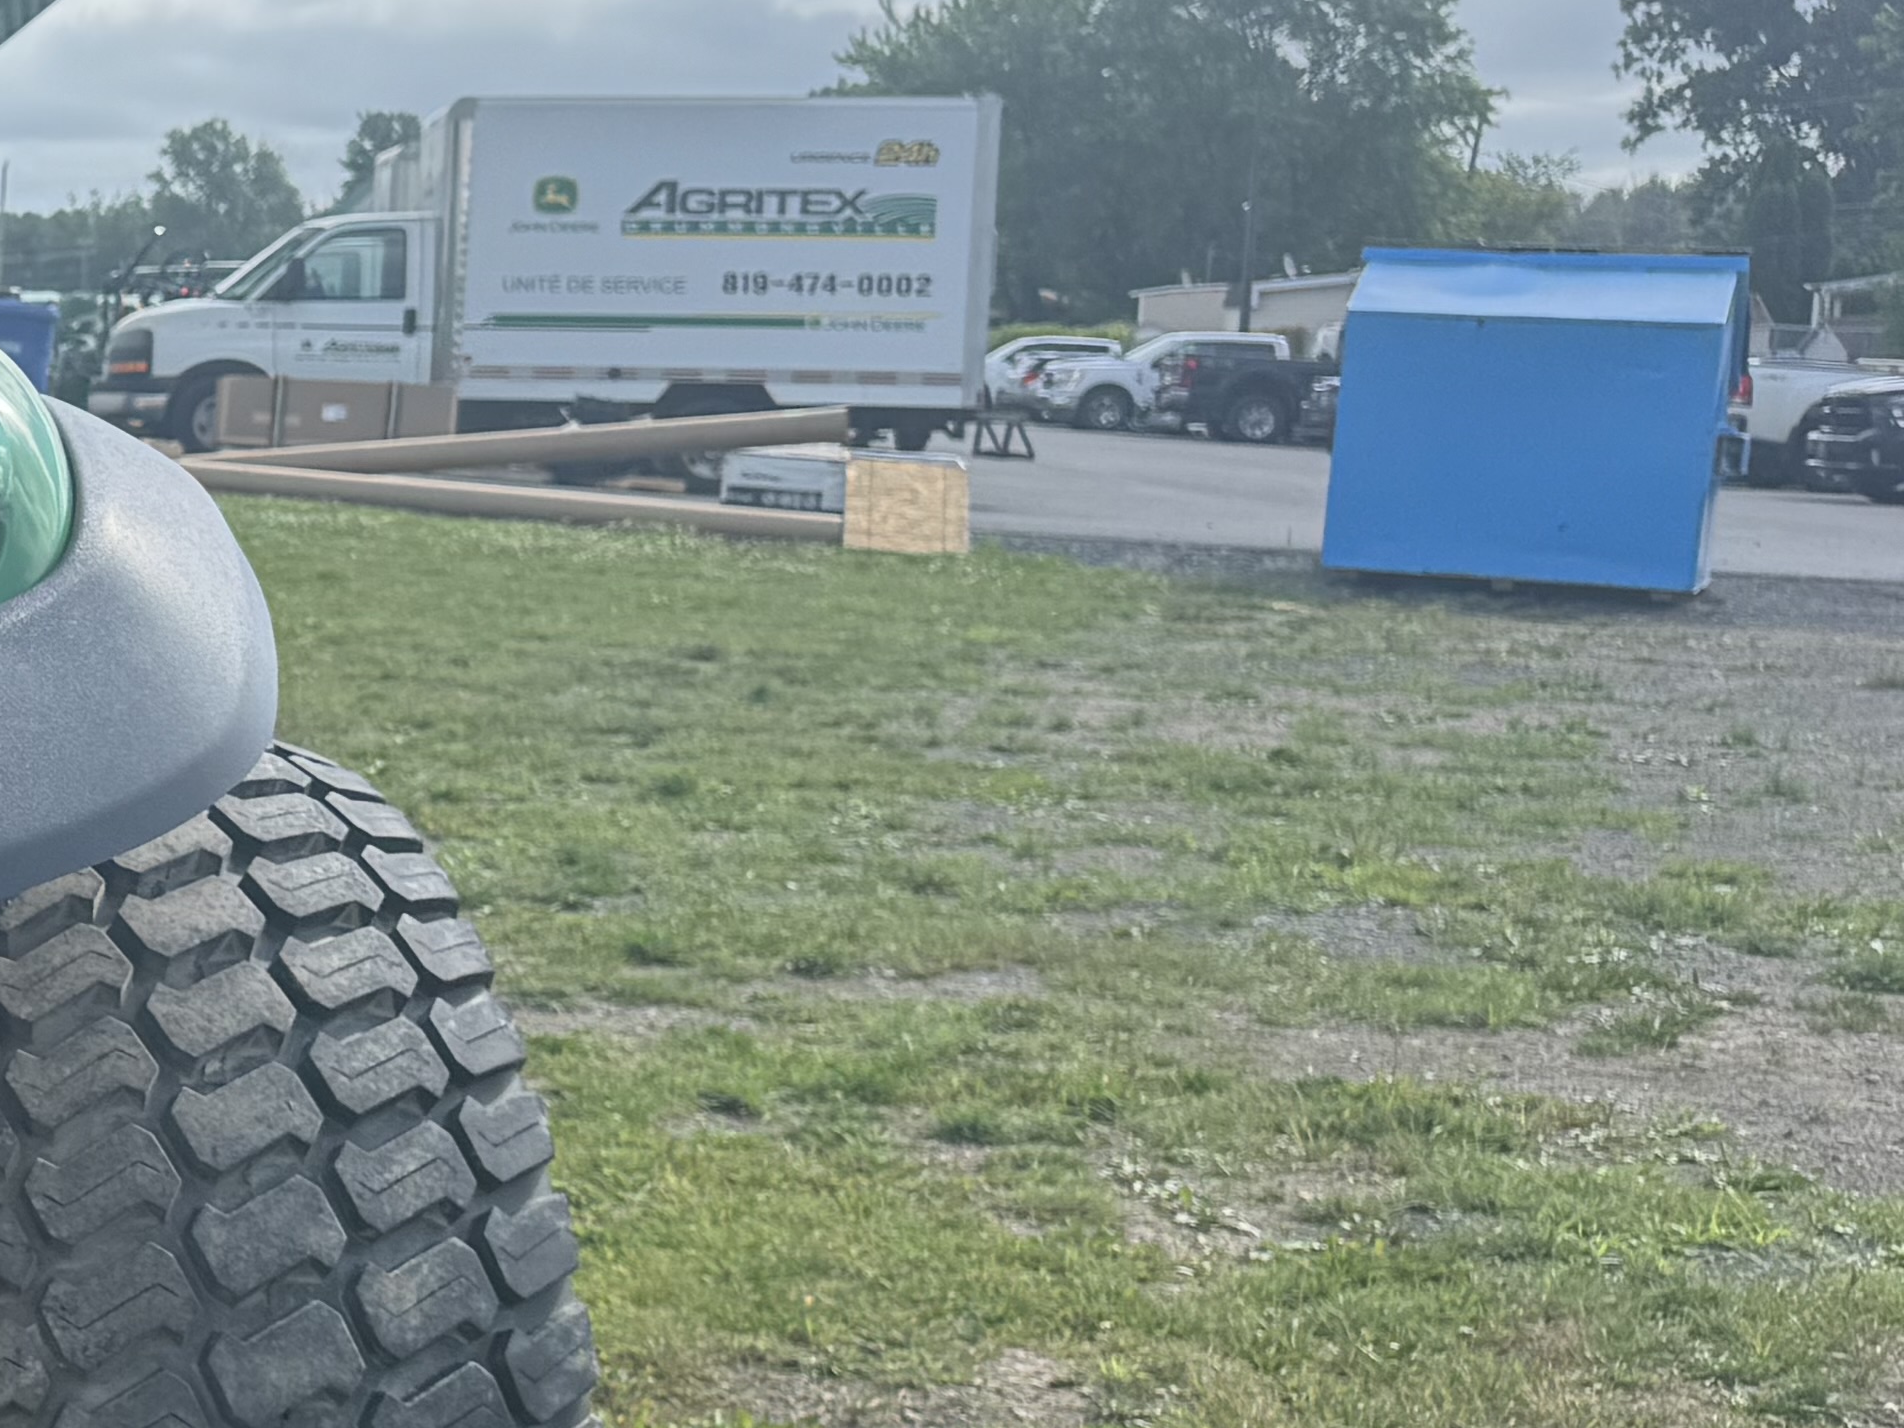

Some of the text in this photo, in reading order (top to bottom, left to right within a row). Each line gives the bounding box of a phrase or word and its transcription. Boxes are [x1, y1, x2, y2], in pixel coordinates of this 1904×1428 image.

[623, 179, 866, 216] AGRITEX
[566, 275, 594, 294] DE
[601, 275, 687, 295] SERVICE
[721, 271, 933, 297] 819-474-0002
